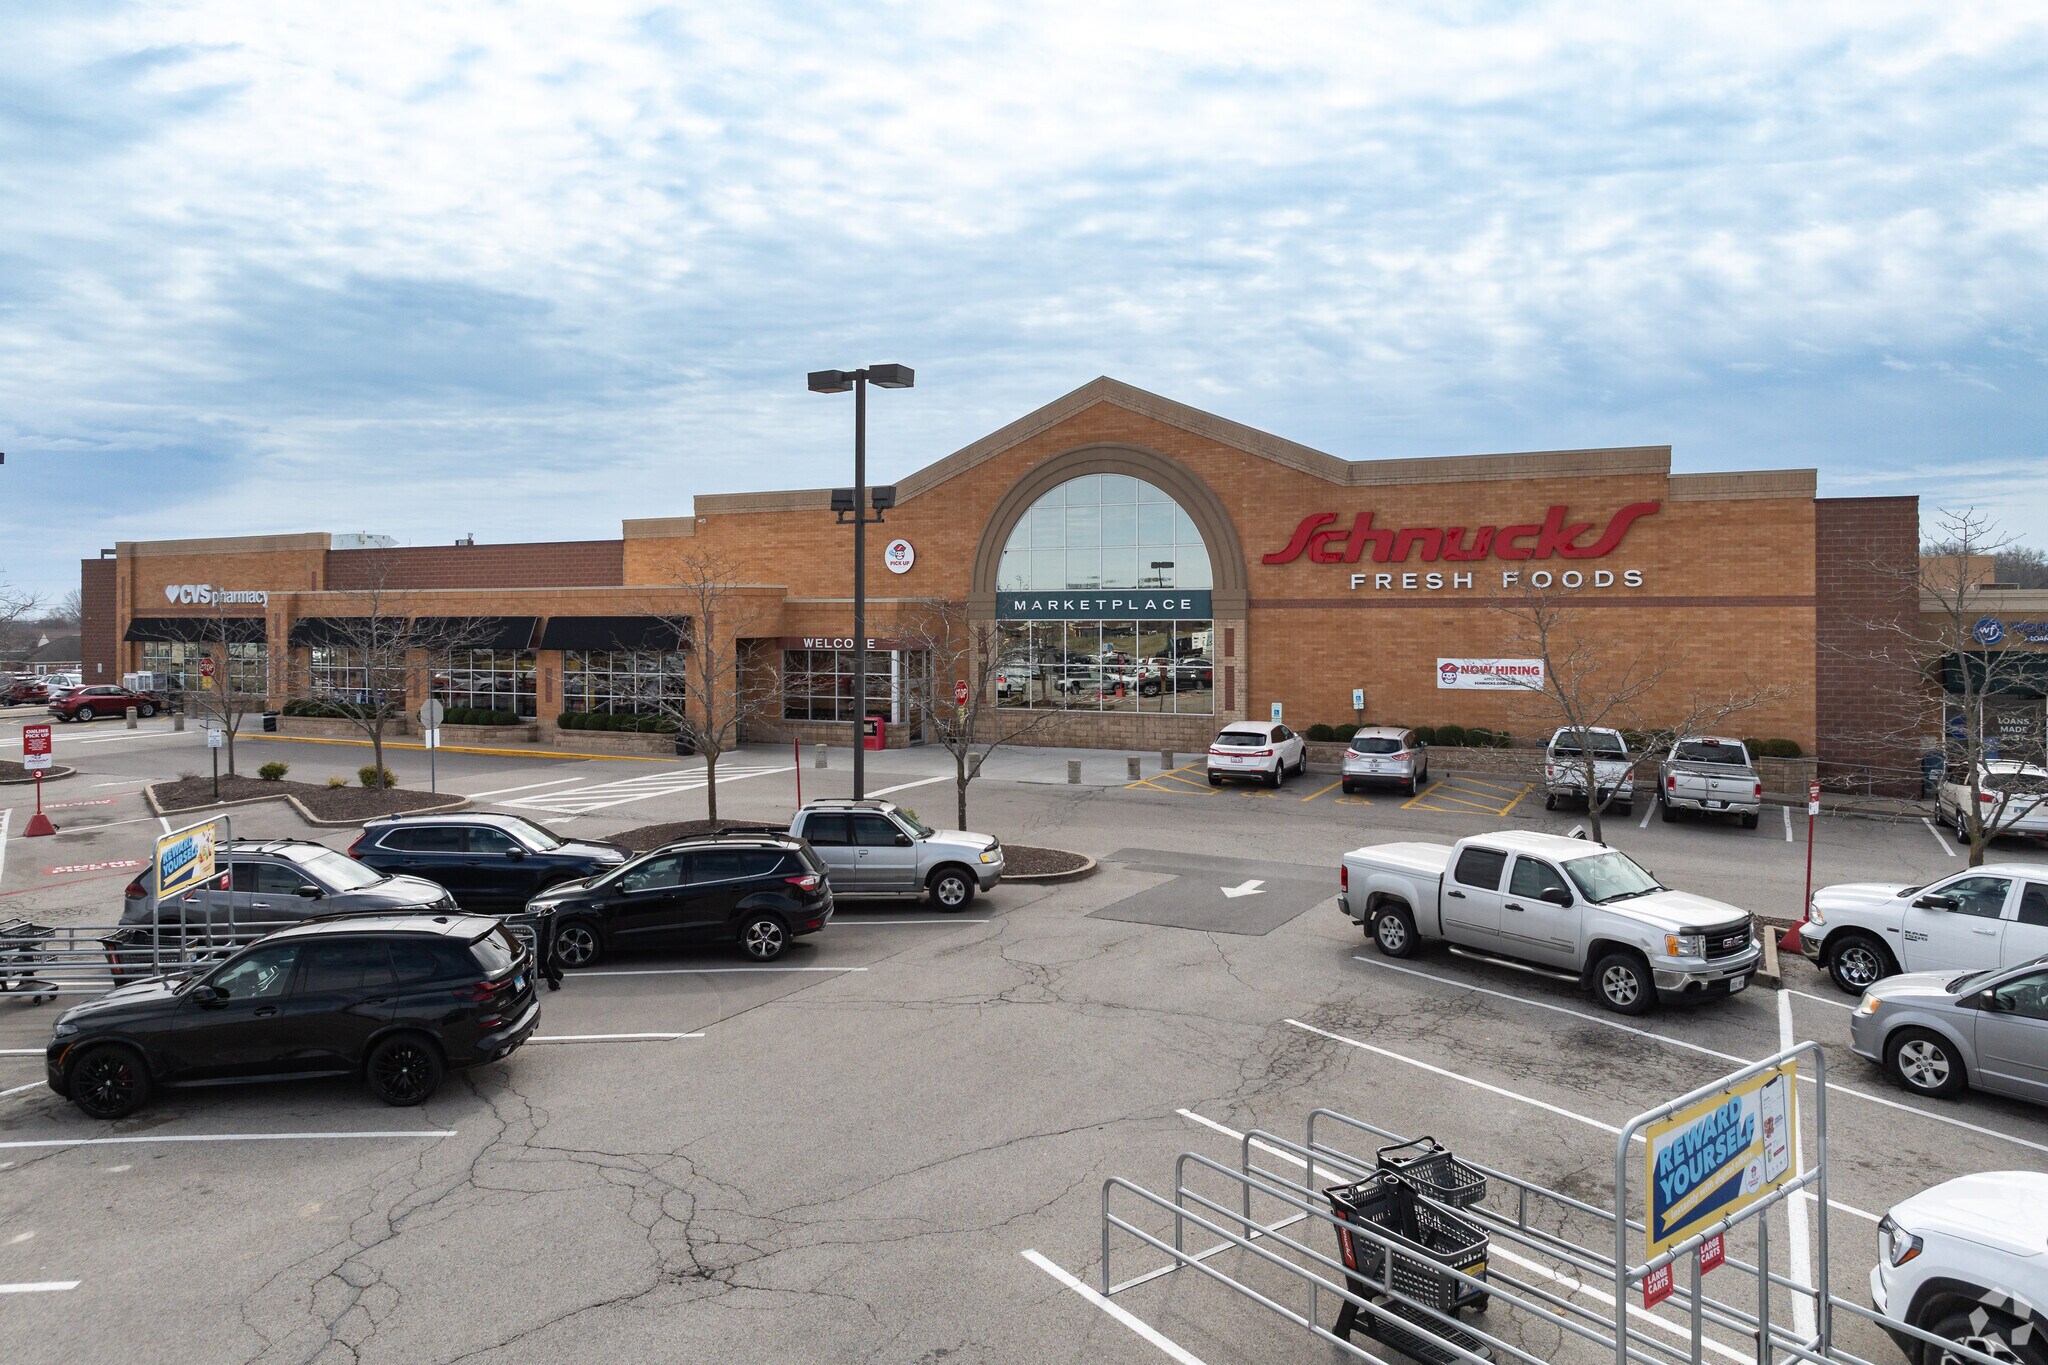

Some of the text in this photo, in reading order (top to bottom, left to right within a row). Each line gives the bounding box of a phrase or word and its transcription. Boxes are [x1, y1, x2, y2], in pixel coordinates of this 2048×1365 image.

[1262, 502, 1661, 565] Schnucks
[1350, 569, 1644, 590] FRESH FOODS
[1014, 599, 1192, 611] MARKETPLACE
[803, 638, 876, 649] WELCOE
[1461, 665, 1540, 676] NOW HIRING
[1998, 717, 2030, 725] LOANS
[2000, 726, 2028, 734] MADE
[35, 770, 42, 778] 3
[161, 836, 194, 865] REWARD
[162, 844, 199, 877] YOURSELF
[1722, 934, 1744, 949] GMC
[1659, 1095, 1743, 1177] REWARD
[1659, 1112, 1755, 1205] YOURSELF
[1700, 1245, 1721, 1263] CARTS
[1701, 1236, 1720, 1254] LARGE
[1647, 1266, 1668, 1285] LARGE
[1648, 1276, 1669, 1295] CARTS
